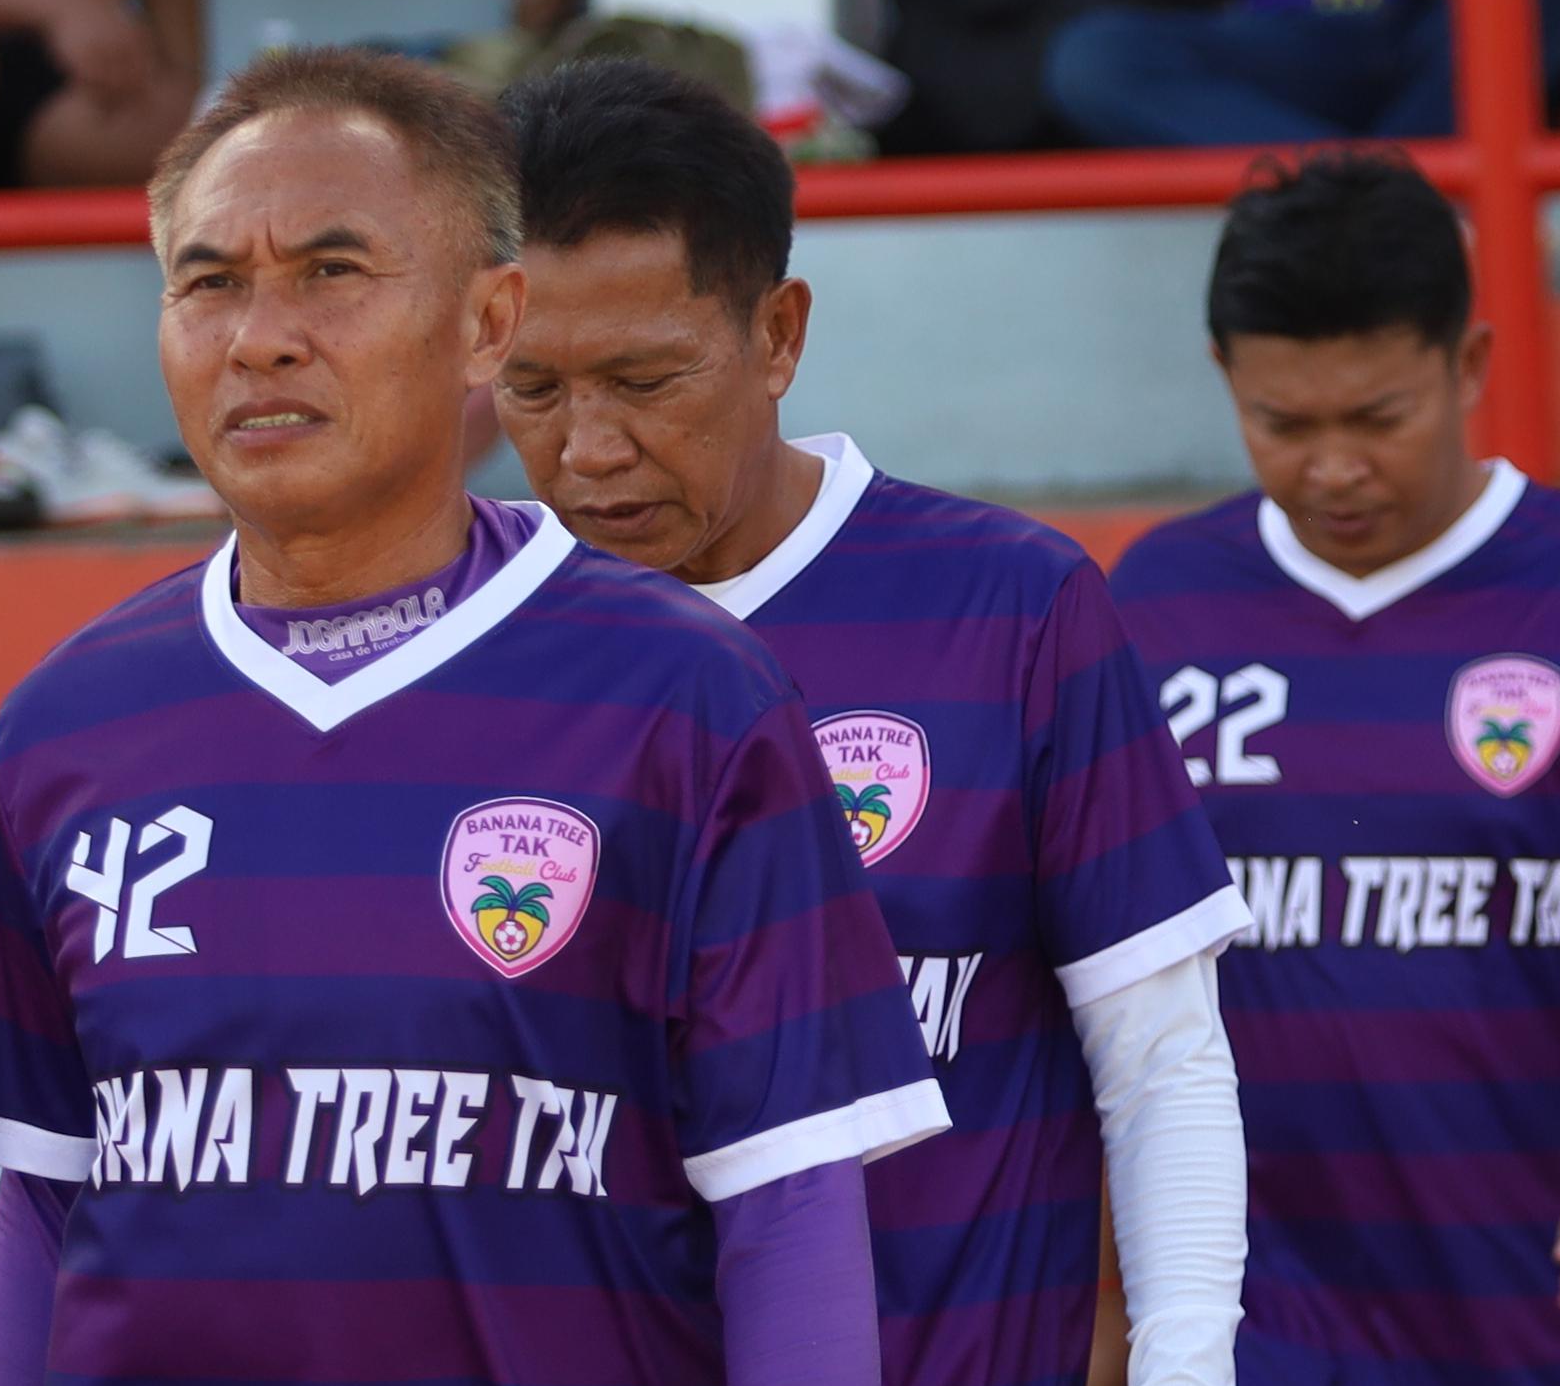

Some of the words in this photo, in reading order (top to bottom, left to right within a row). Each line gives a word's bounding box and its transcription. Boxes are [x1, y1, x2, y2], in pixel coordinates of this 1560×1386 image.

[282, 587, 449, 656] JOGARBOLA
[328, 651, 354, 661] casa
[355, 645, 371, 656] de
[878, 727, 915, 747] TREE
[1159, 661, 1290, 788] 22
[838, 744, 883, 763] TAK
[875, 763, 910, 782] Club
[466, 814, 542, 835] BANANA
[547, 818, 589, 847] TREE
[499, 834, 552, 858] TAK
[66, 804, 214, 965] 42
[539, 859, 577, 883] Club
[1340, 856, 1498, 954] TREE
[897, 951, 984, 1063] AK
[92, 1067, 253, 1193] NANA
[286, 1068, 490, 1197] TREE
